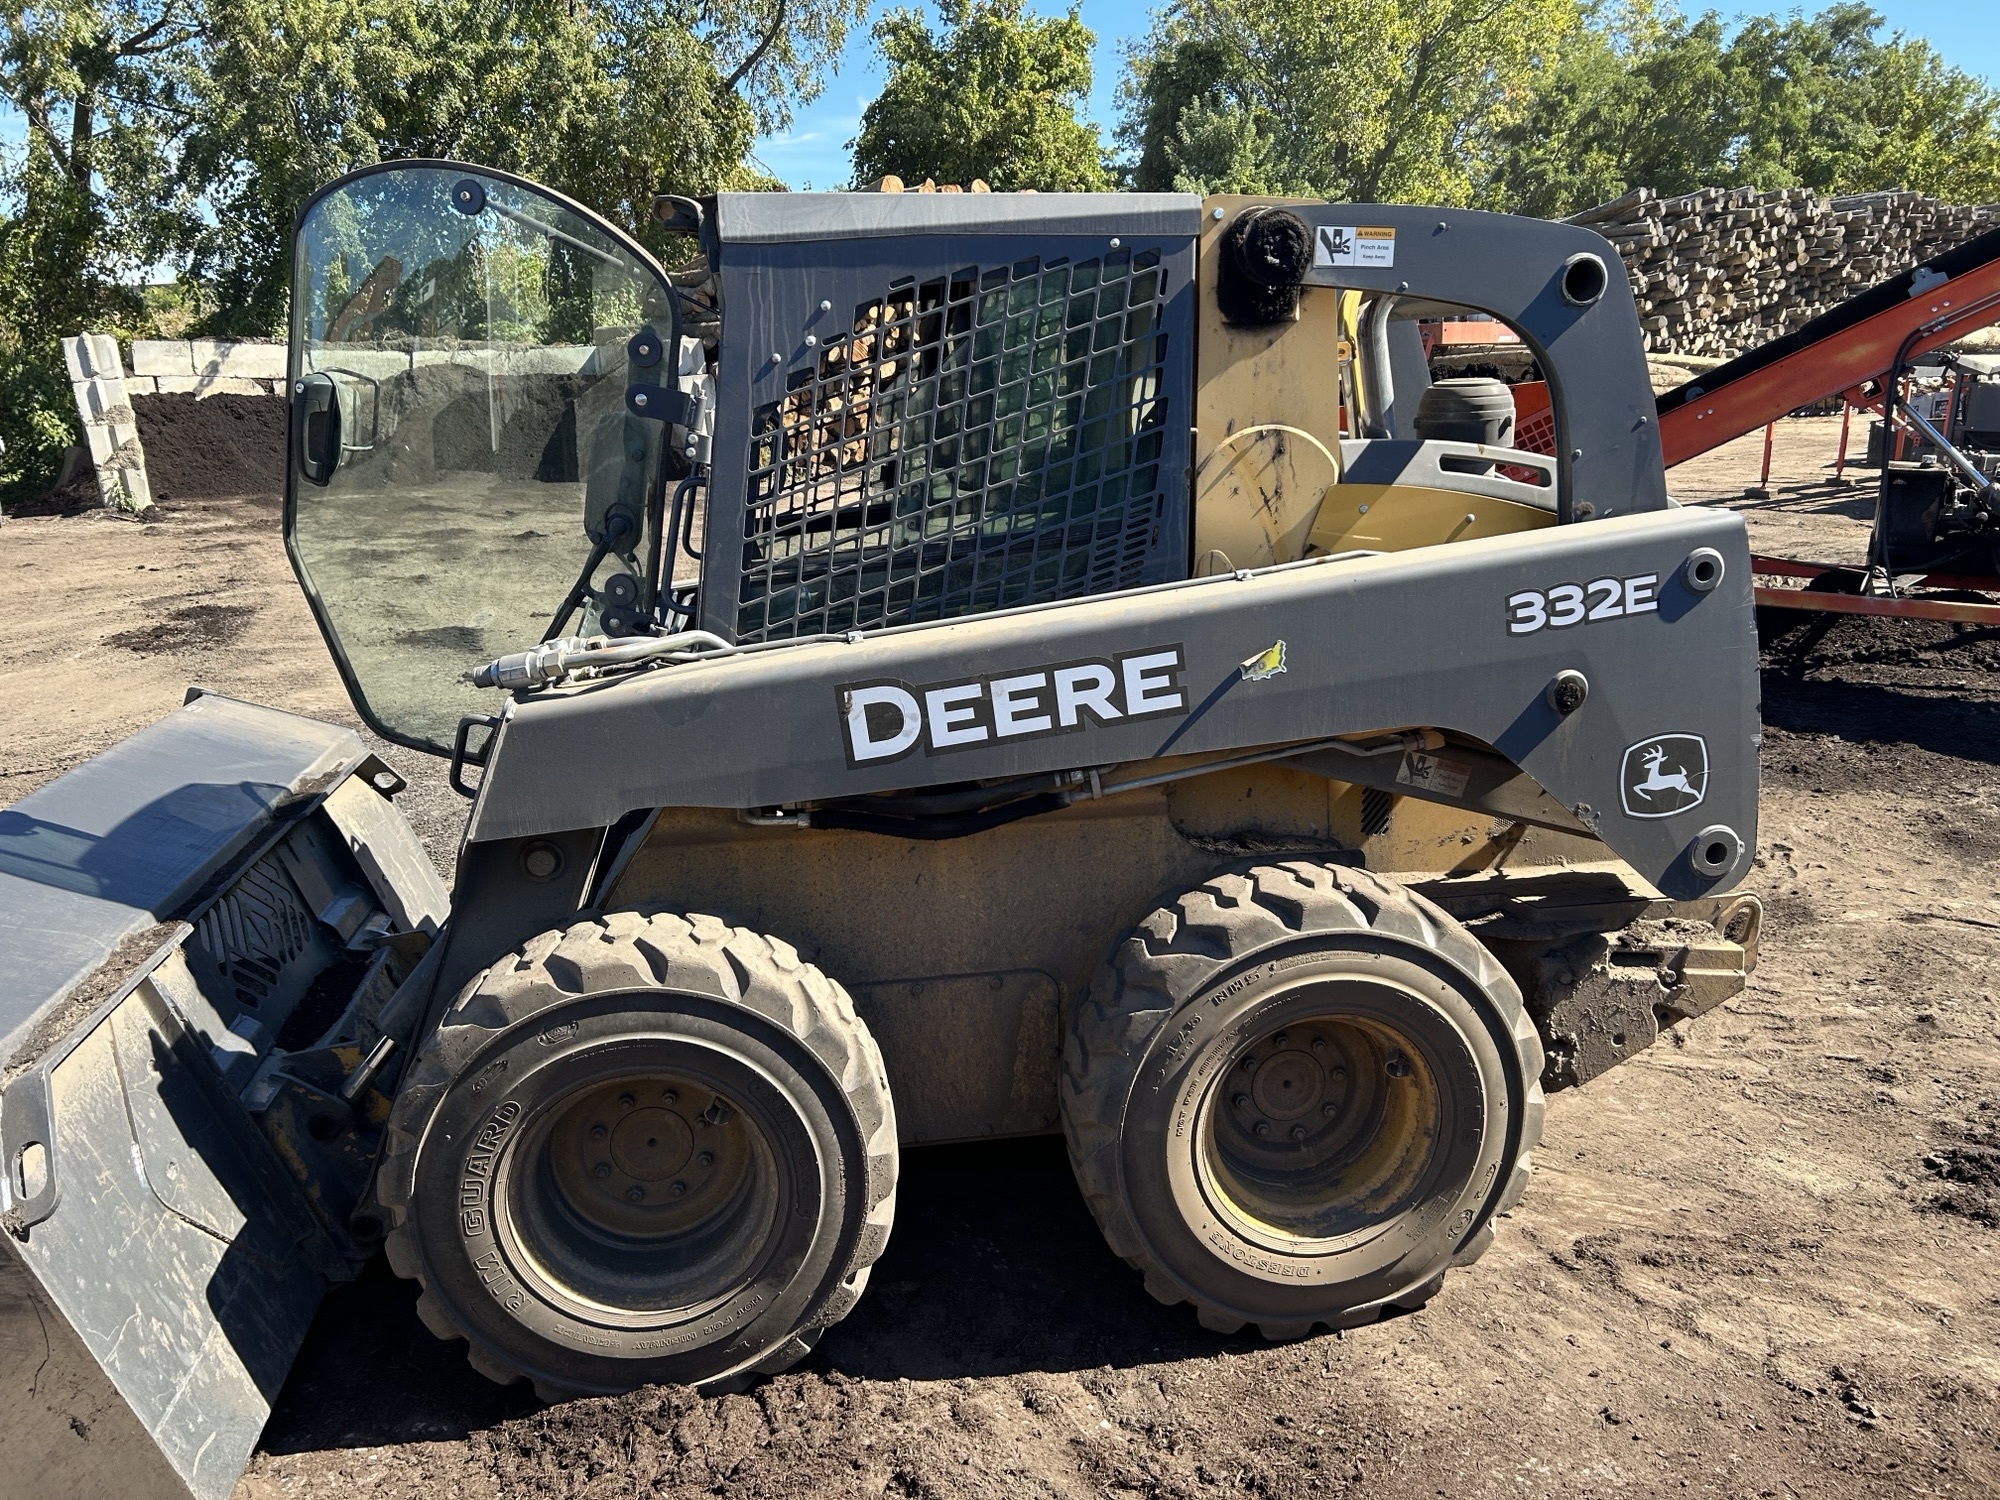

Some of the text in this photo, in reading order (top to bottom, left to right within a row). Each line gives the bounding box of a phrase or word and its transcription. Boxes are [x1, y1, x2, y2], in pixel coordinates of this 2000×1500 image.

[1509, 574, 1658, 633] 332E
[844, 650, 1183, 762] DEERE
[1211, 970, 1262, 1008] NHS
[1176, 1111, 1187, 1137] NOT
[461, 1100, 522, 1237] GUARD
[1208, 1231, 1311, 1278] DEESTONE
[474, 1250, 534, 1317] RIM
[703, 1315, 734, 1336] FOR
[737, 1294, 763, 1319] NOT
[631, 1331, 698, 1350] HIGHWAY
